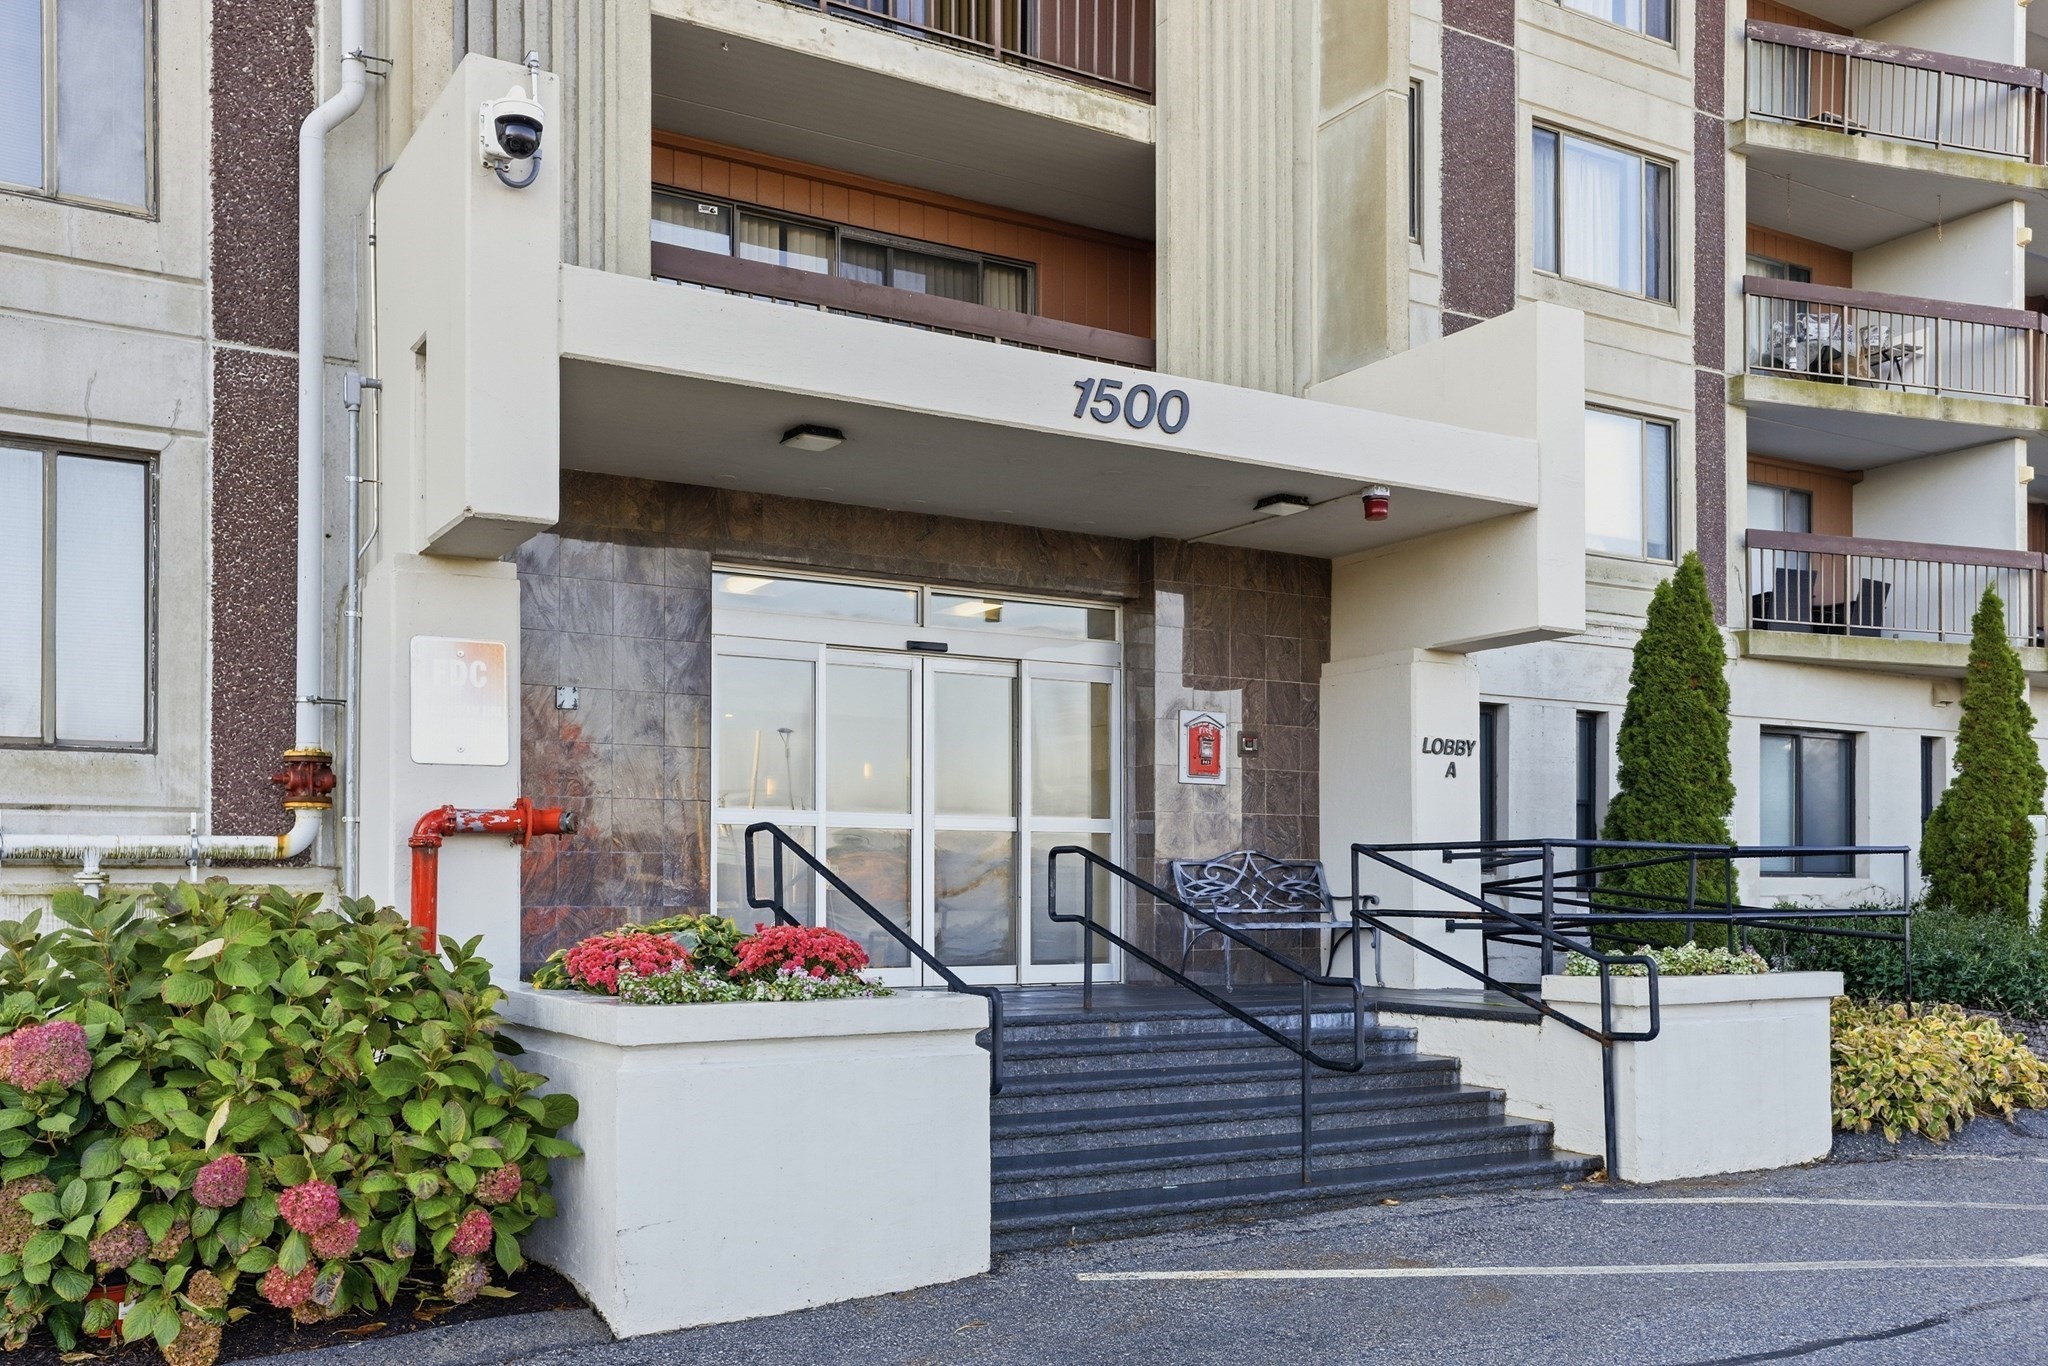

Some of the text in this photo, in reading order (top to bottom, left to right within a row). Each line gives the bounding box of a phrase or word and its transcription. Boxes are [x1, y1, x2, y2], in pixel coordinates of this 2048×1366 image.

[1073, 377, 1190, 434] 1500
[1422, 737, 1477, 757] LOBBY
[1445, 761, 1457, 779] A
